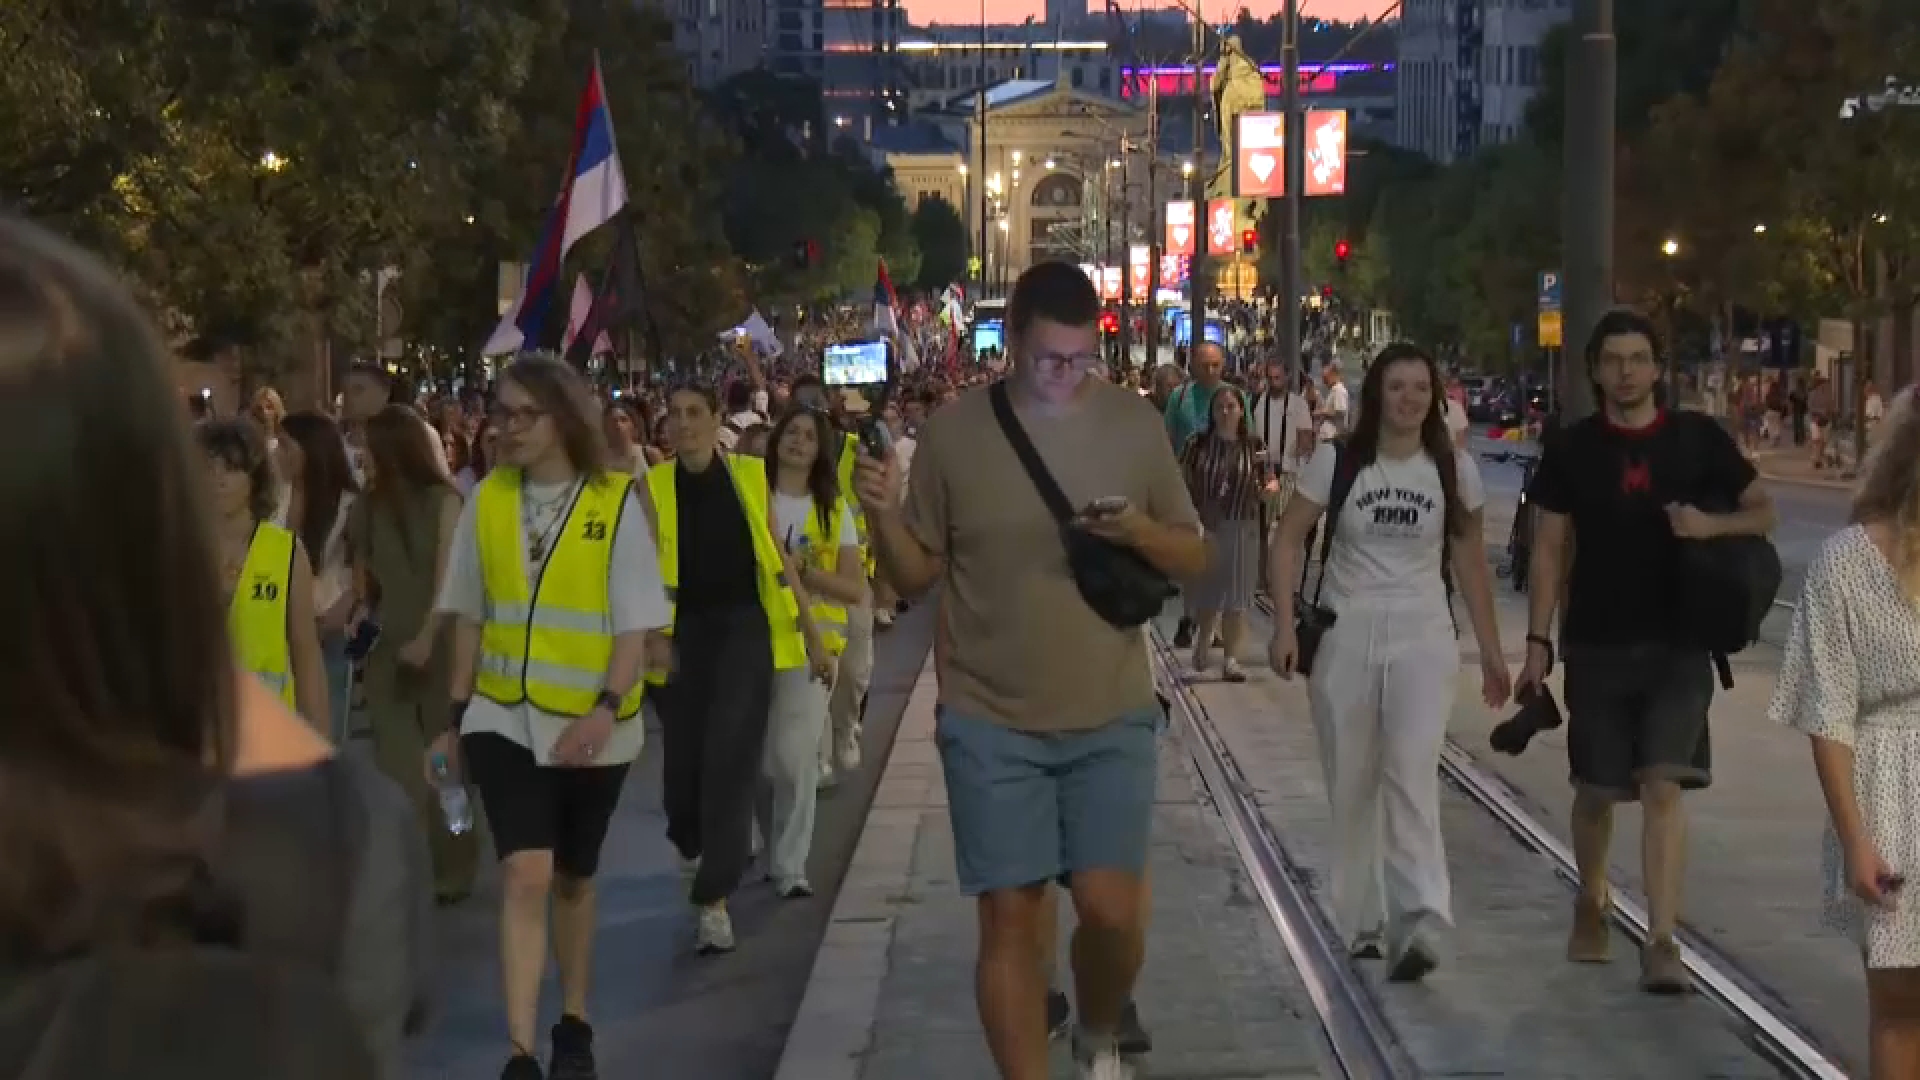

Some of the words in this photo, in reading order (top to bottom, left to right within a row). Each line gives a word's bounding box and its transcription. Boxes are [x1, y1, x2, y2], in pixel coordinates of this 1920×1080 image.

[1543, 273, 1557, 291] P
[1356, 488, 1391, 511] NEW
[1395, 488, 1435, 513] YORK
[1373, 506, 1419, 525] 1990
[582, 520, 607, 541] 13
